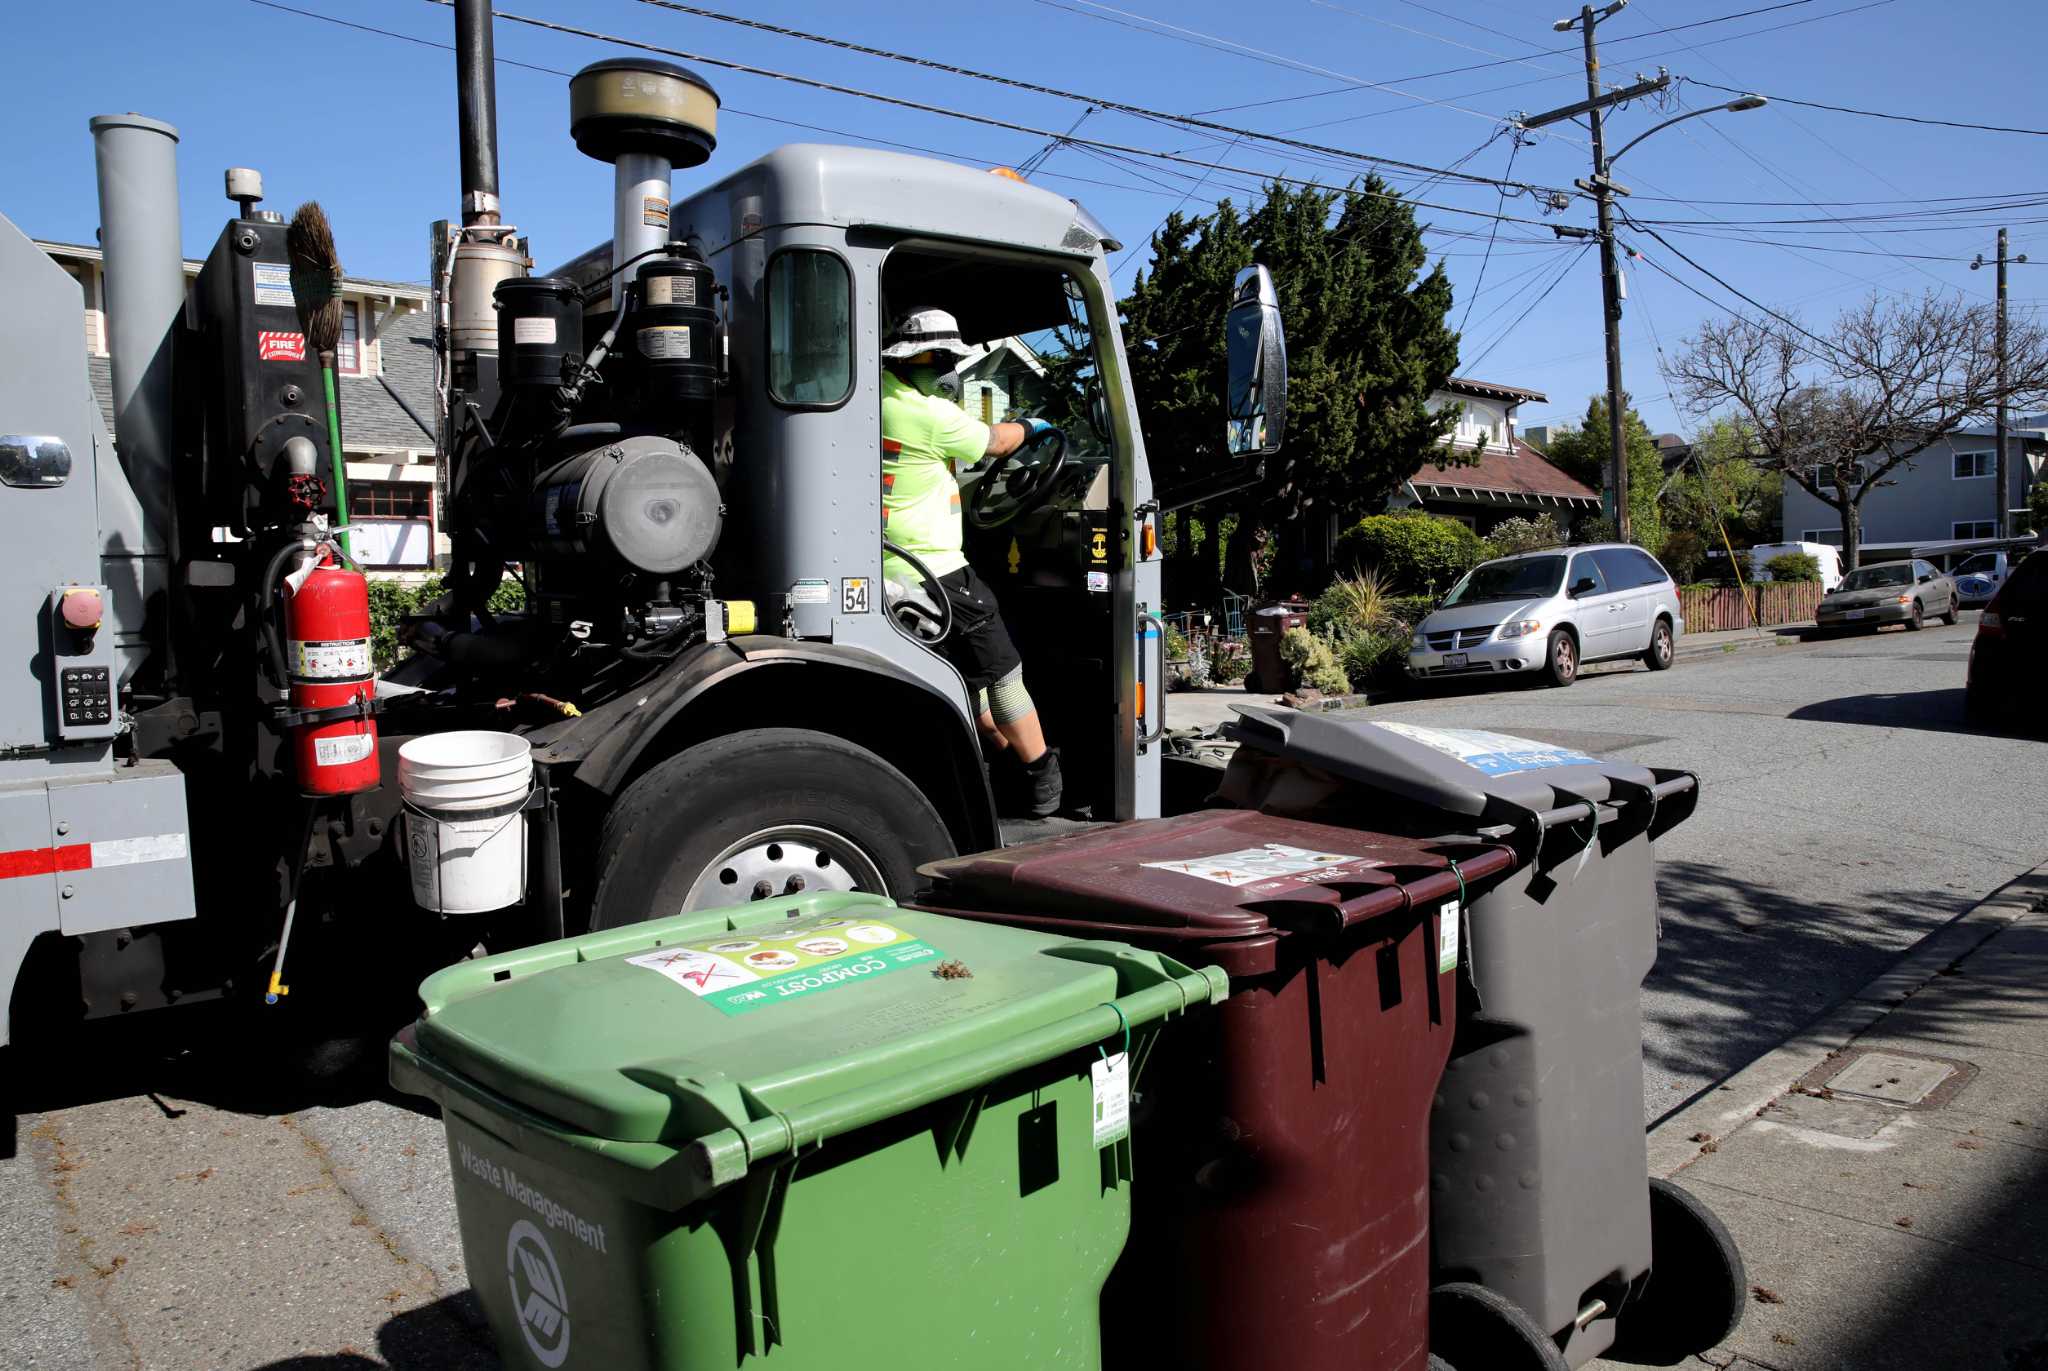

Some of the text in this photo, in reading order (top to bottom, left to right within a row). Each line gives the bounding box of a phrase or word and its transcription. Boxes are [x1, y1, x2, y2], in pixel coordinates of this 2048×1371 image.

[269, 340, 296, 350] FIRE
[845, 587, 866, 610] 54
[776, 959, 887, 997] COMPOST
[457, 1141, 608, 1254] Waste Management
